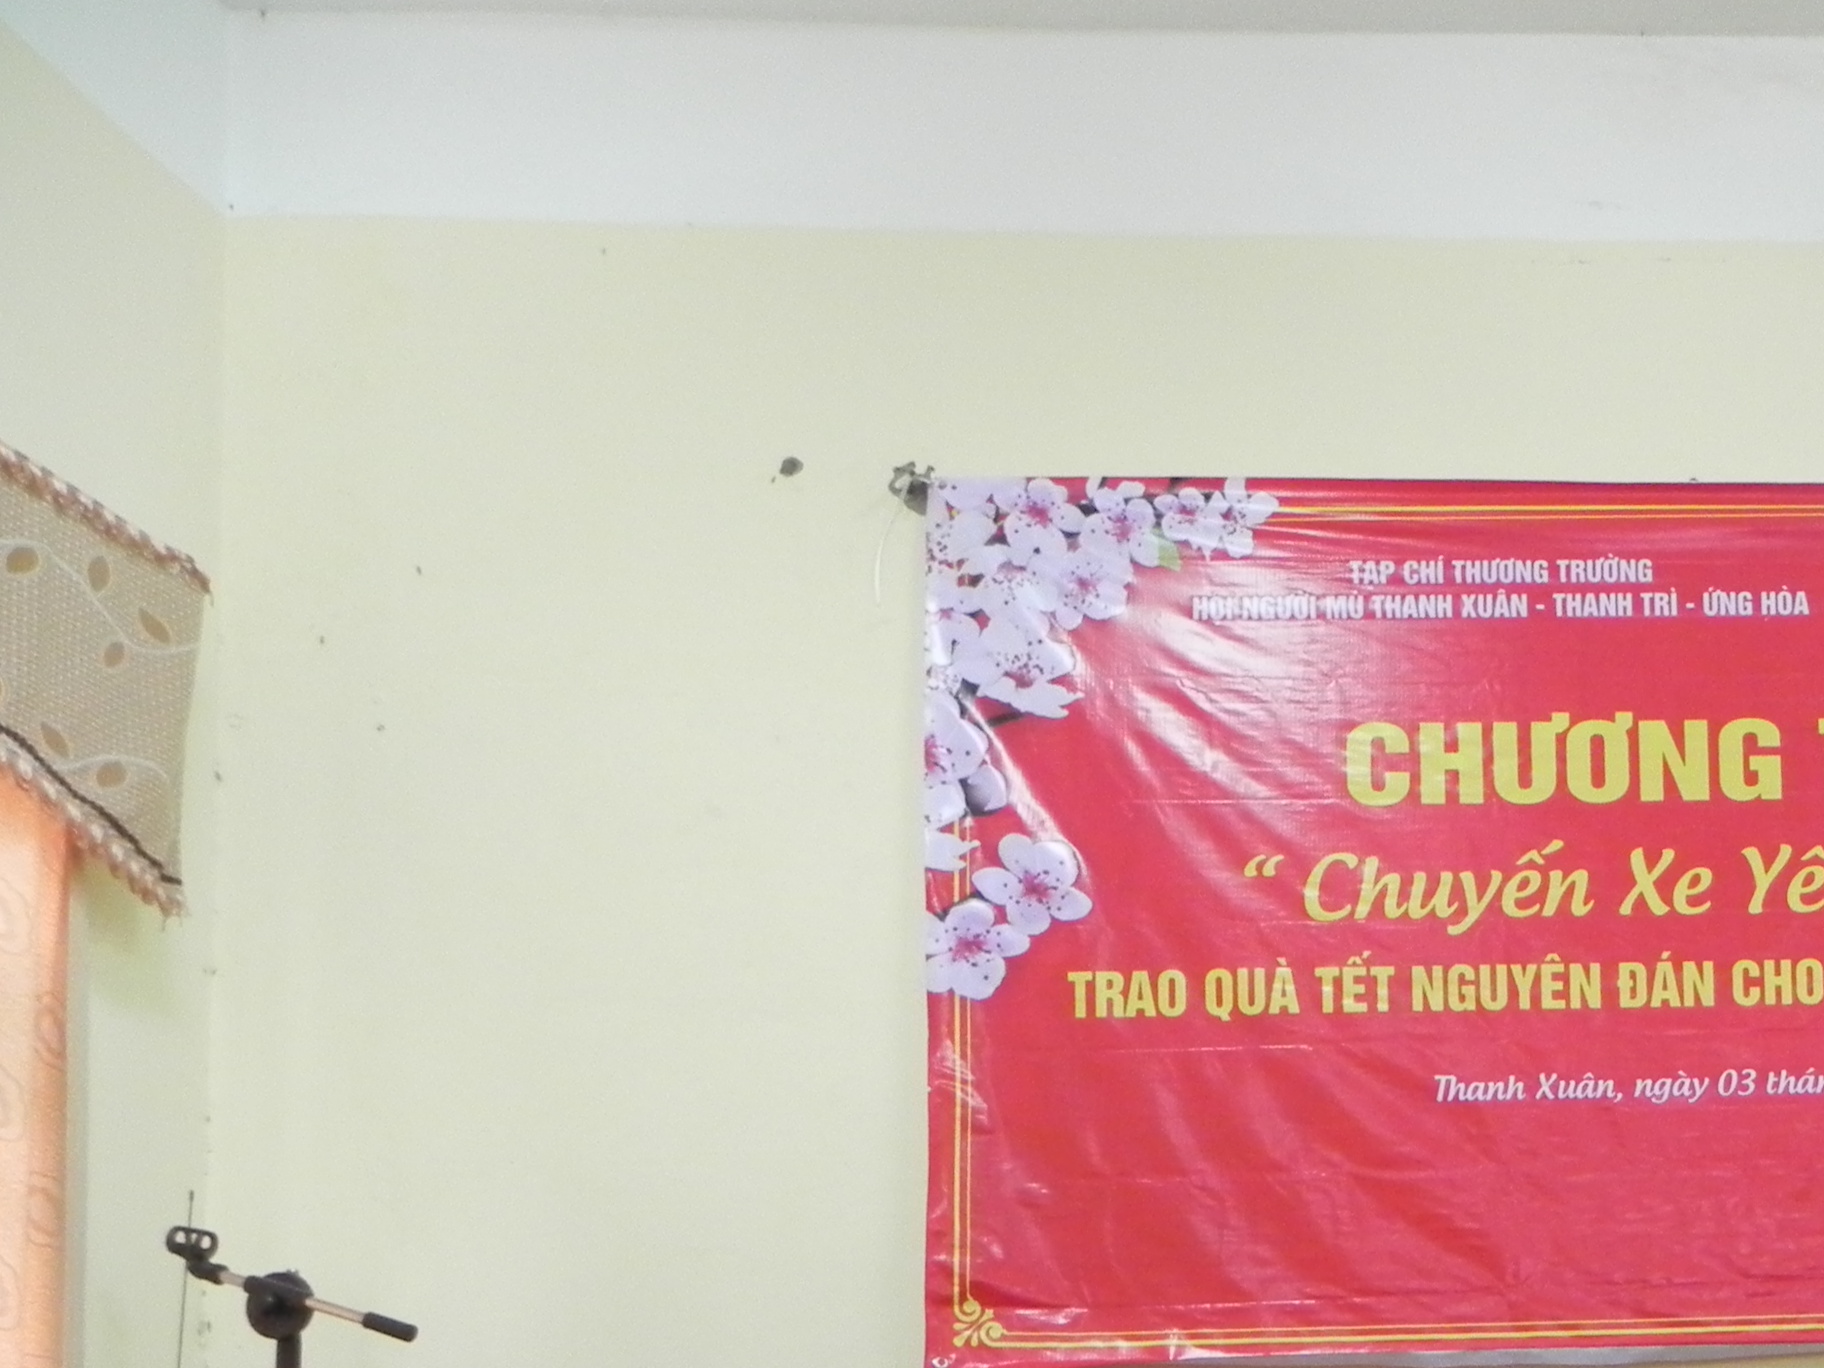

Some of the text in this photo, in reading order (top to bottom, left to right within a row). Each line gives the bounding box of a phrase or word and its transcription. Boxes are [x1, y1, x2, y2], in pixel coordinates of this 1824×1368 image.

[1350, 552, 1654, 590] TẠP CHÍ THƯƠNG TRƯỜNG
[1325, 590, 1365, 620] MÙ
[1372, 594, 1453, 620] THANH
[1460, 588, 1529, 619] XUÂN
[1552, 592, 1633, 618] THANH
[1640, 586, 1678, 617] TRÌ
[1703, 586, 1754, 617] ỨNG
[1760, 585, 1810, 616] HÒA
[1345, 711, 1783, 807] CHƯƠNG
[1302, 839, 1595, 936] Chuyến
[1618, 846, 1713, 917] Xe
[1067, 969, 1188, 1019] TRAO
[1204, 957, 1301, 1023] QUÀ
[1313, 949, 1395, 1014] TẾT
[1411, 953, 1602, 1013] NGUYÊN
[1617, 949, 1715, 1008] ĐÁN
[1731, 958, 1824, 1007] CHO
[1434, 1073, 1526, 1103] Thanh
[1535, 1071, 1624, 1104] Xuân,
[1633, 1069, 1709, 1105] ngày
[1716, 1067, 1757, 1097] 03
